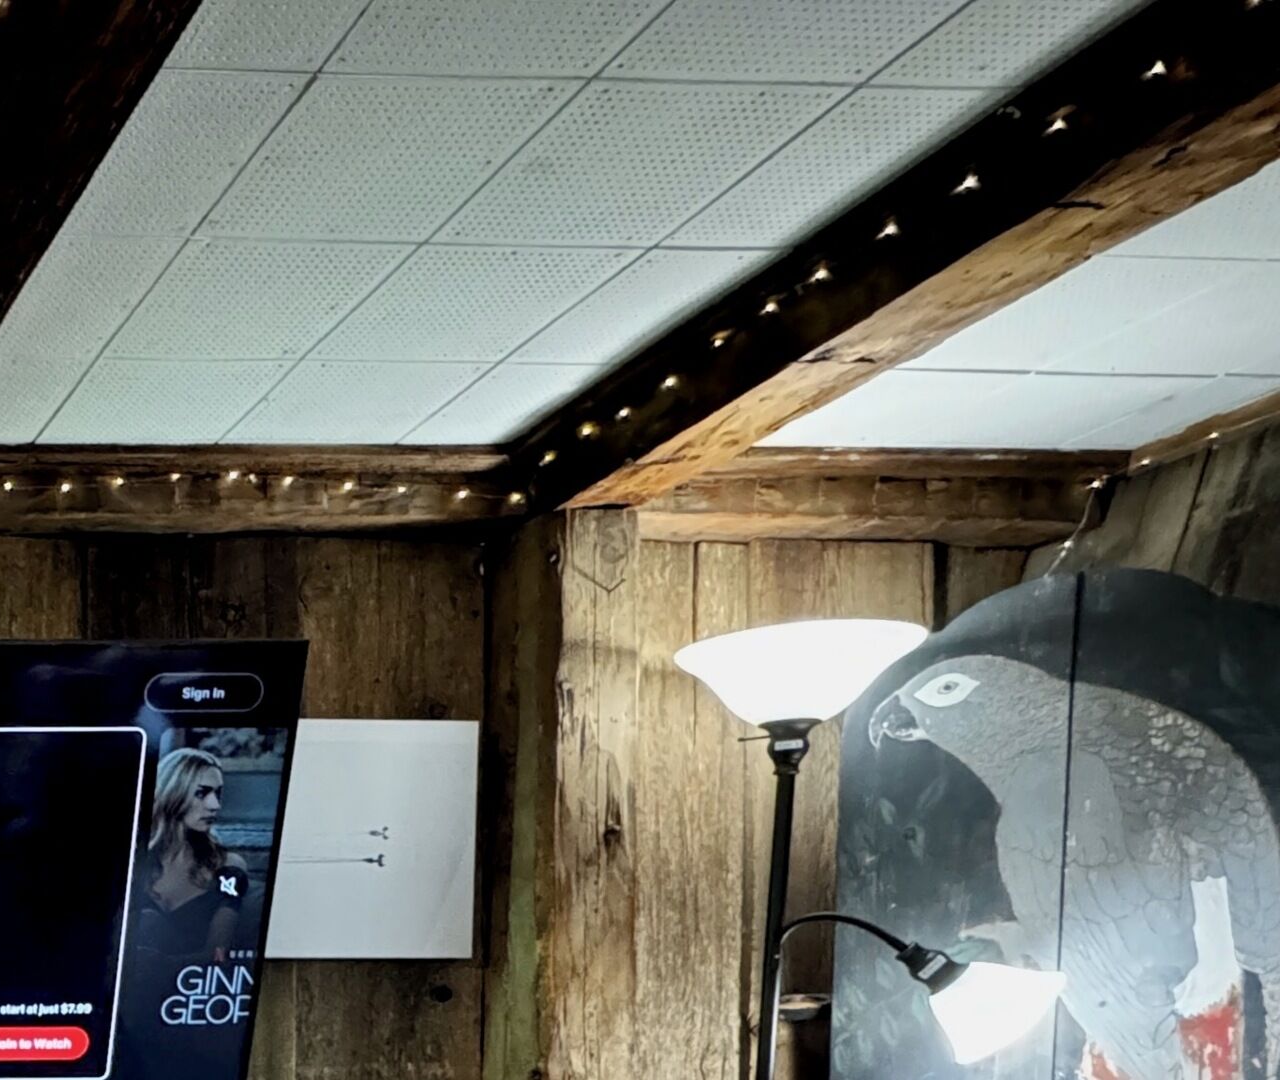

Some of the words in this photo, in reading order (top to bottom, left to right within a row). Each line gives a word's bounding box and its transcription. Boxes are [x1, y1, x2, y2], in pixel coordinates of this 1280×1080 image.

[182, 686, 210, 702] Sign
[213, 687, 225, 699] In
[0, 1004, 25, 1015] start
[26, 1004, 38, 1014] at
[38, 1003, 59, 1018] just
[19, 1038, 32, 1050] to
[33, 1037, 72, 1050] Watch
